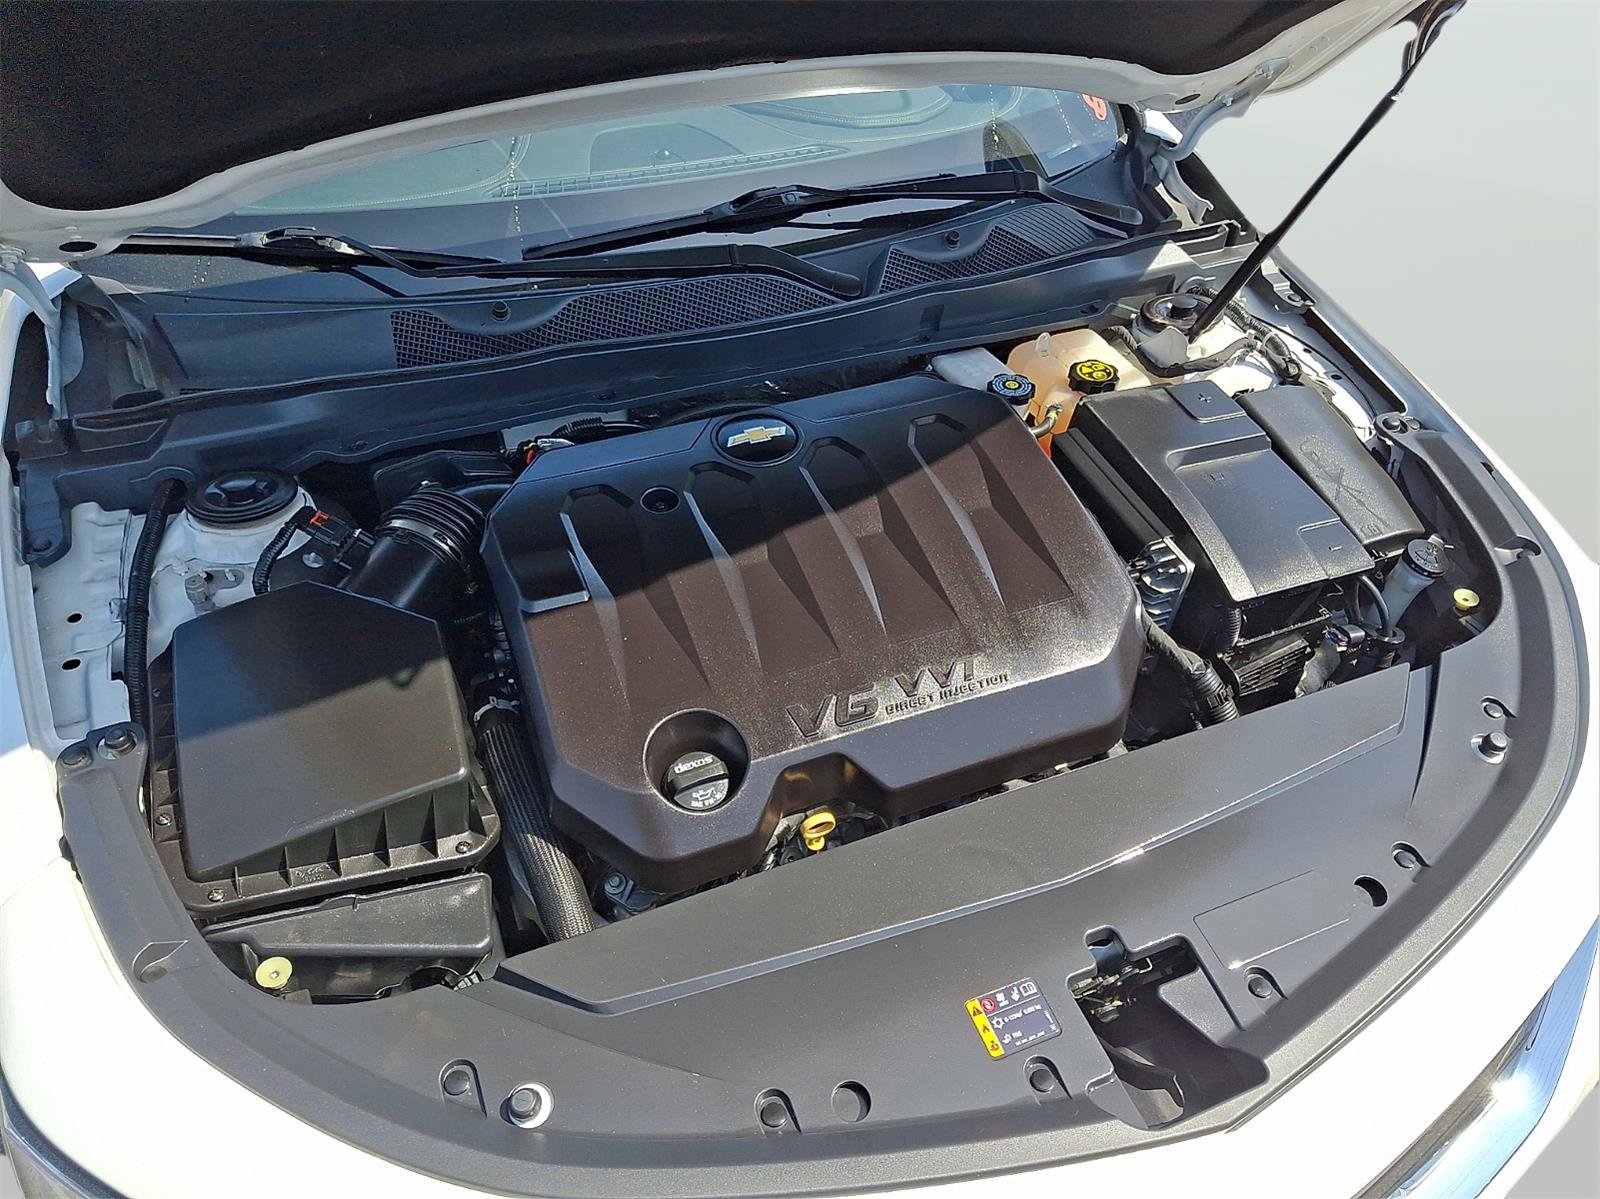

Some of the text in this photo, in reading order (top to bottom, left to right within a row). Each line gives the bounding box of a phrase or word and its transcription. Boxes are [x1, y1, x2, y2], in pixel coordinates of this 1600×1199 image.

[786, 682, 879, 737] V6
[885, 673, 1009, 714] DIRECT INJECTION
[674, 755, 713, 774] dexos
